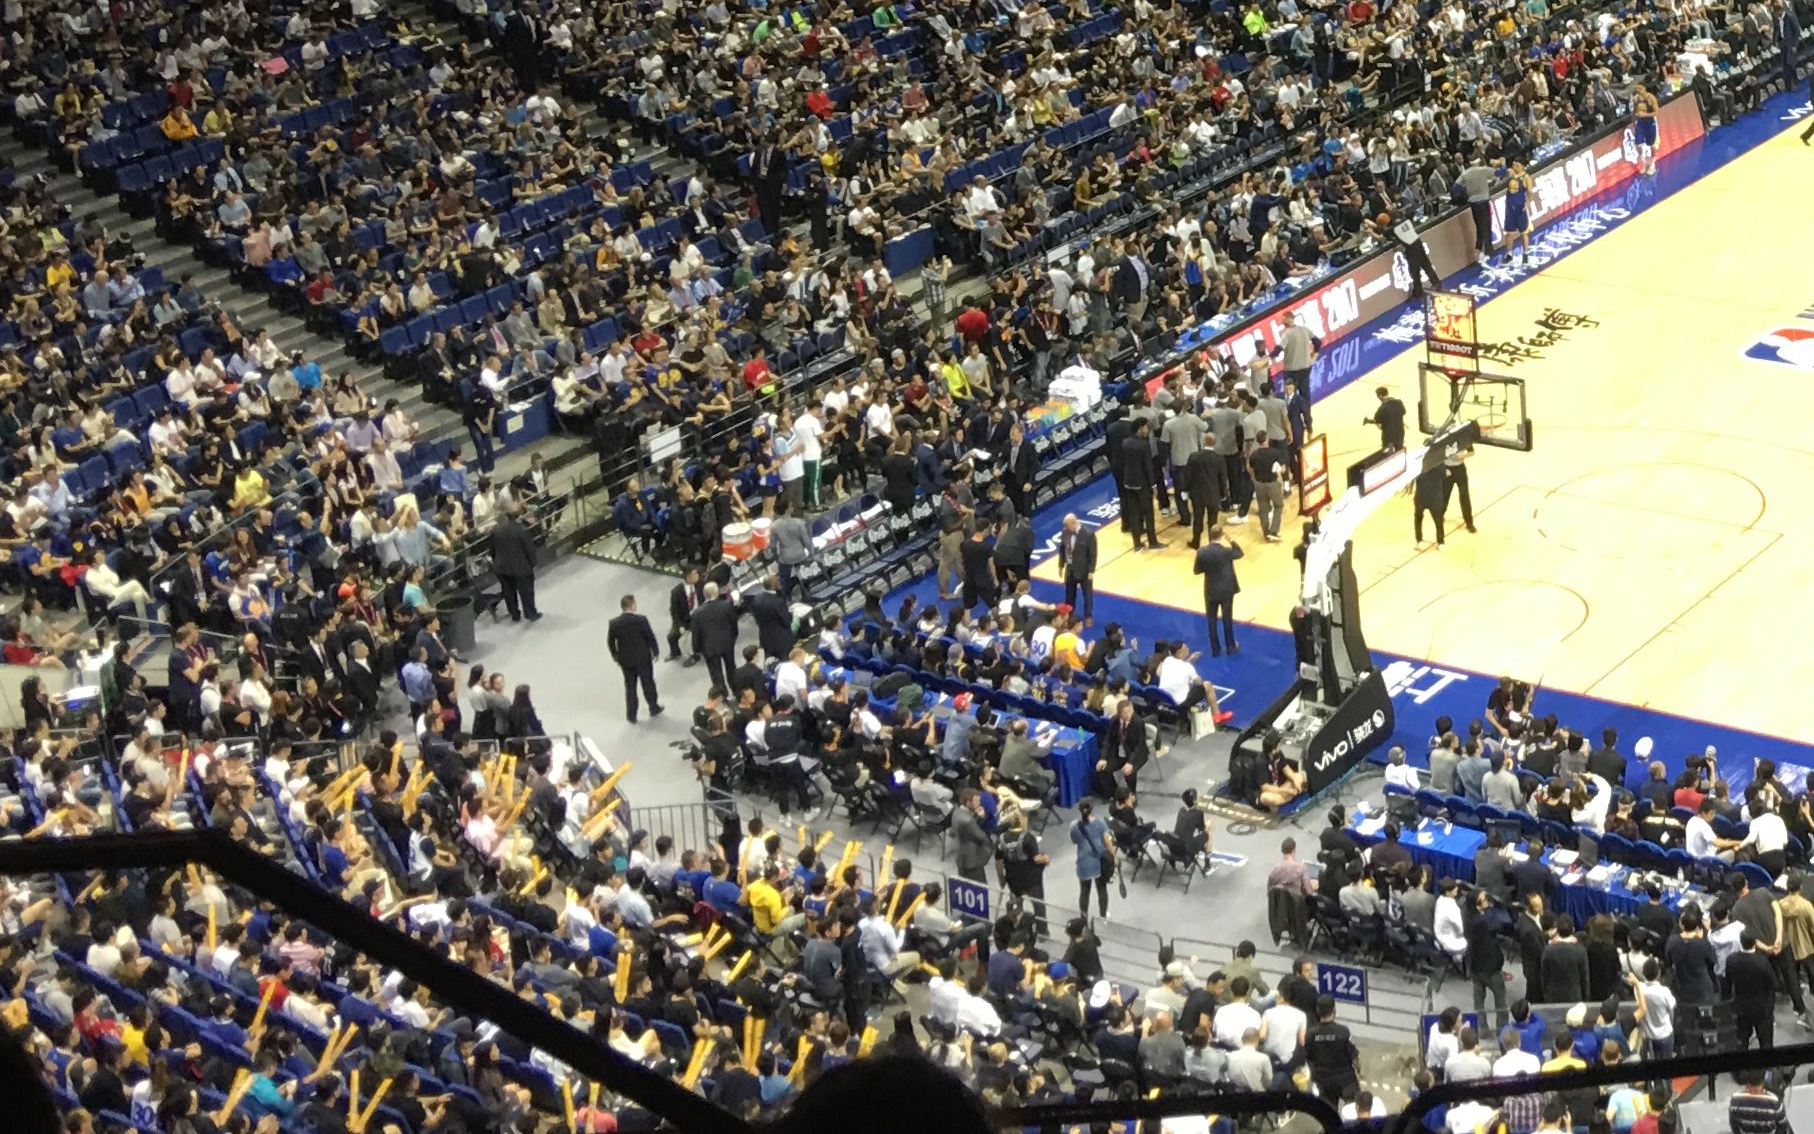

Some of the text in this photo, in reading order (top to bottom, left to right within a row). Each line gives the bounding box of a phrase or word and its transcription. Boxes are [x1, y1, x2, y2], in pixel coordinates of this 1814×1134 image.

[1322, 278, 1359, 329] 2017
[1441, 341, 1473, 355] TISSOT
[1314, 740, 1348, 771] vivo
[955, 886, 985, 912] 101
[1323, 971, 1362, 996] 122
